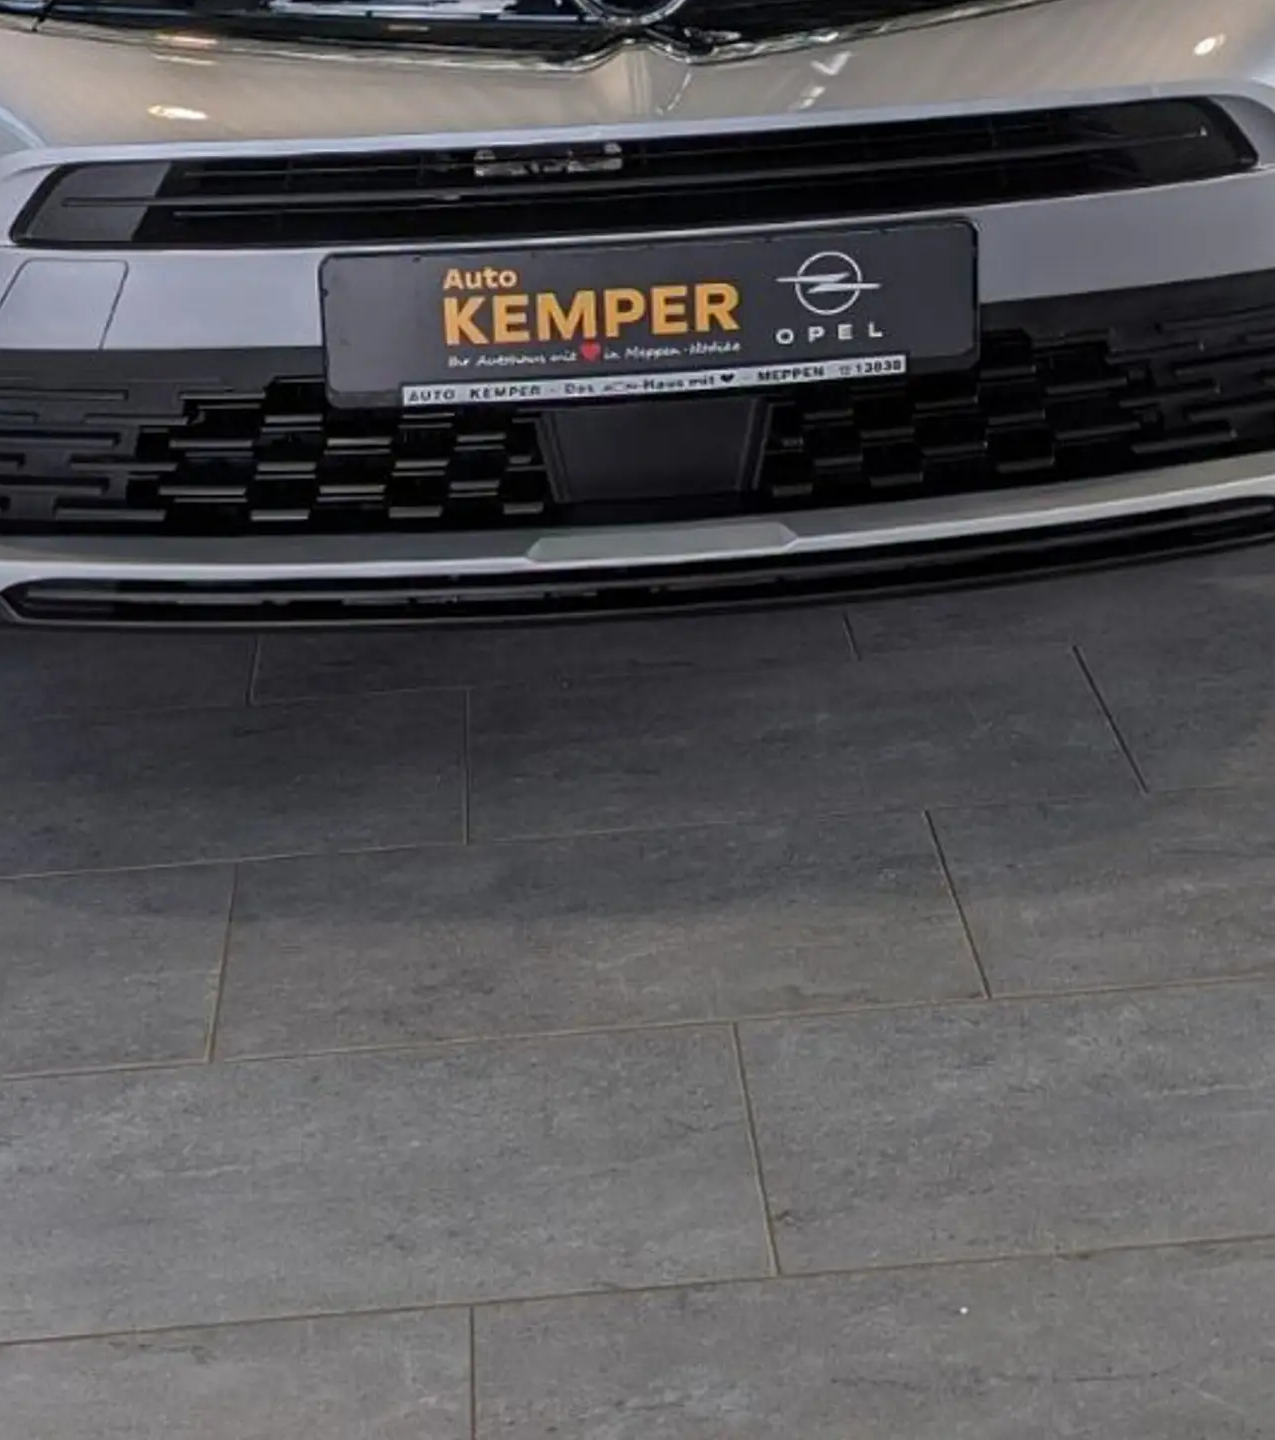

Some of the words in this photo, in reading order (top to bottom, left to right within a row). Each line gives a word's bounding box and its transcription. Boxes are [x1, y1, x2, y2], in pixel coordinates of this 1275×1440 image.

[443, 267, 517, 290] Auto
[443, 282, 741, 346] KEMPER
[775, 321, 883, 345] OPEL
[408, 388, 456, 402] AUTO
[469, 384, 542, 400] KEMPER
[757, 365, 825, 381] MEPPEN
